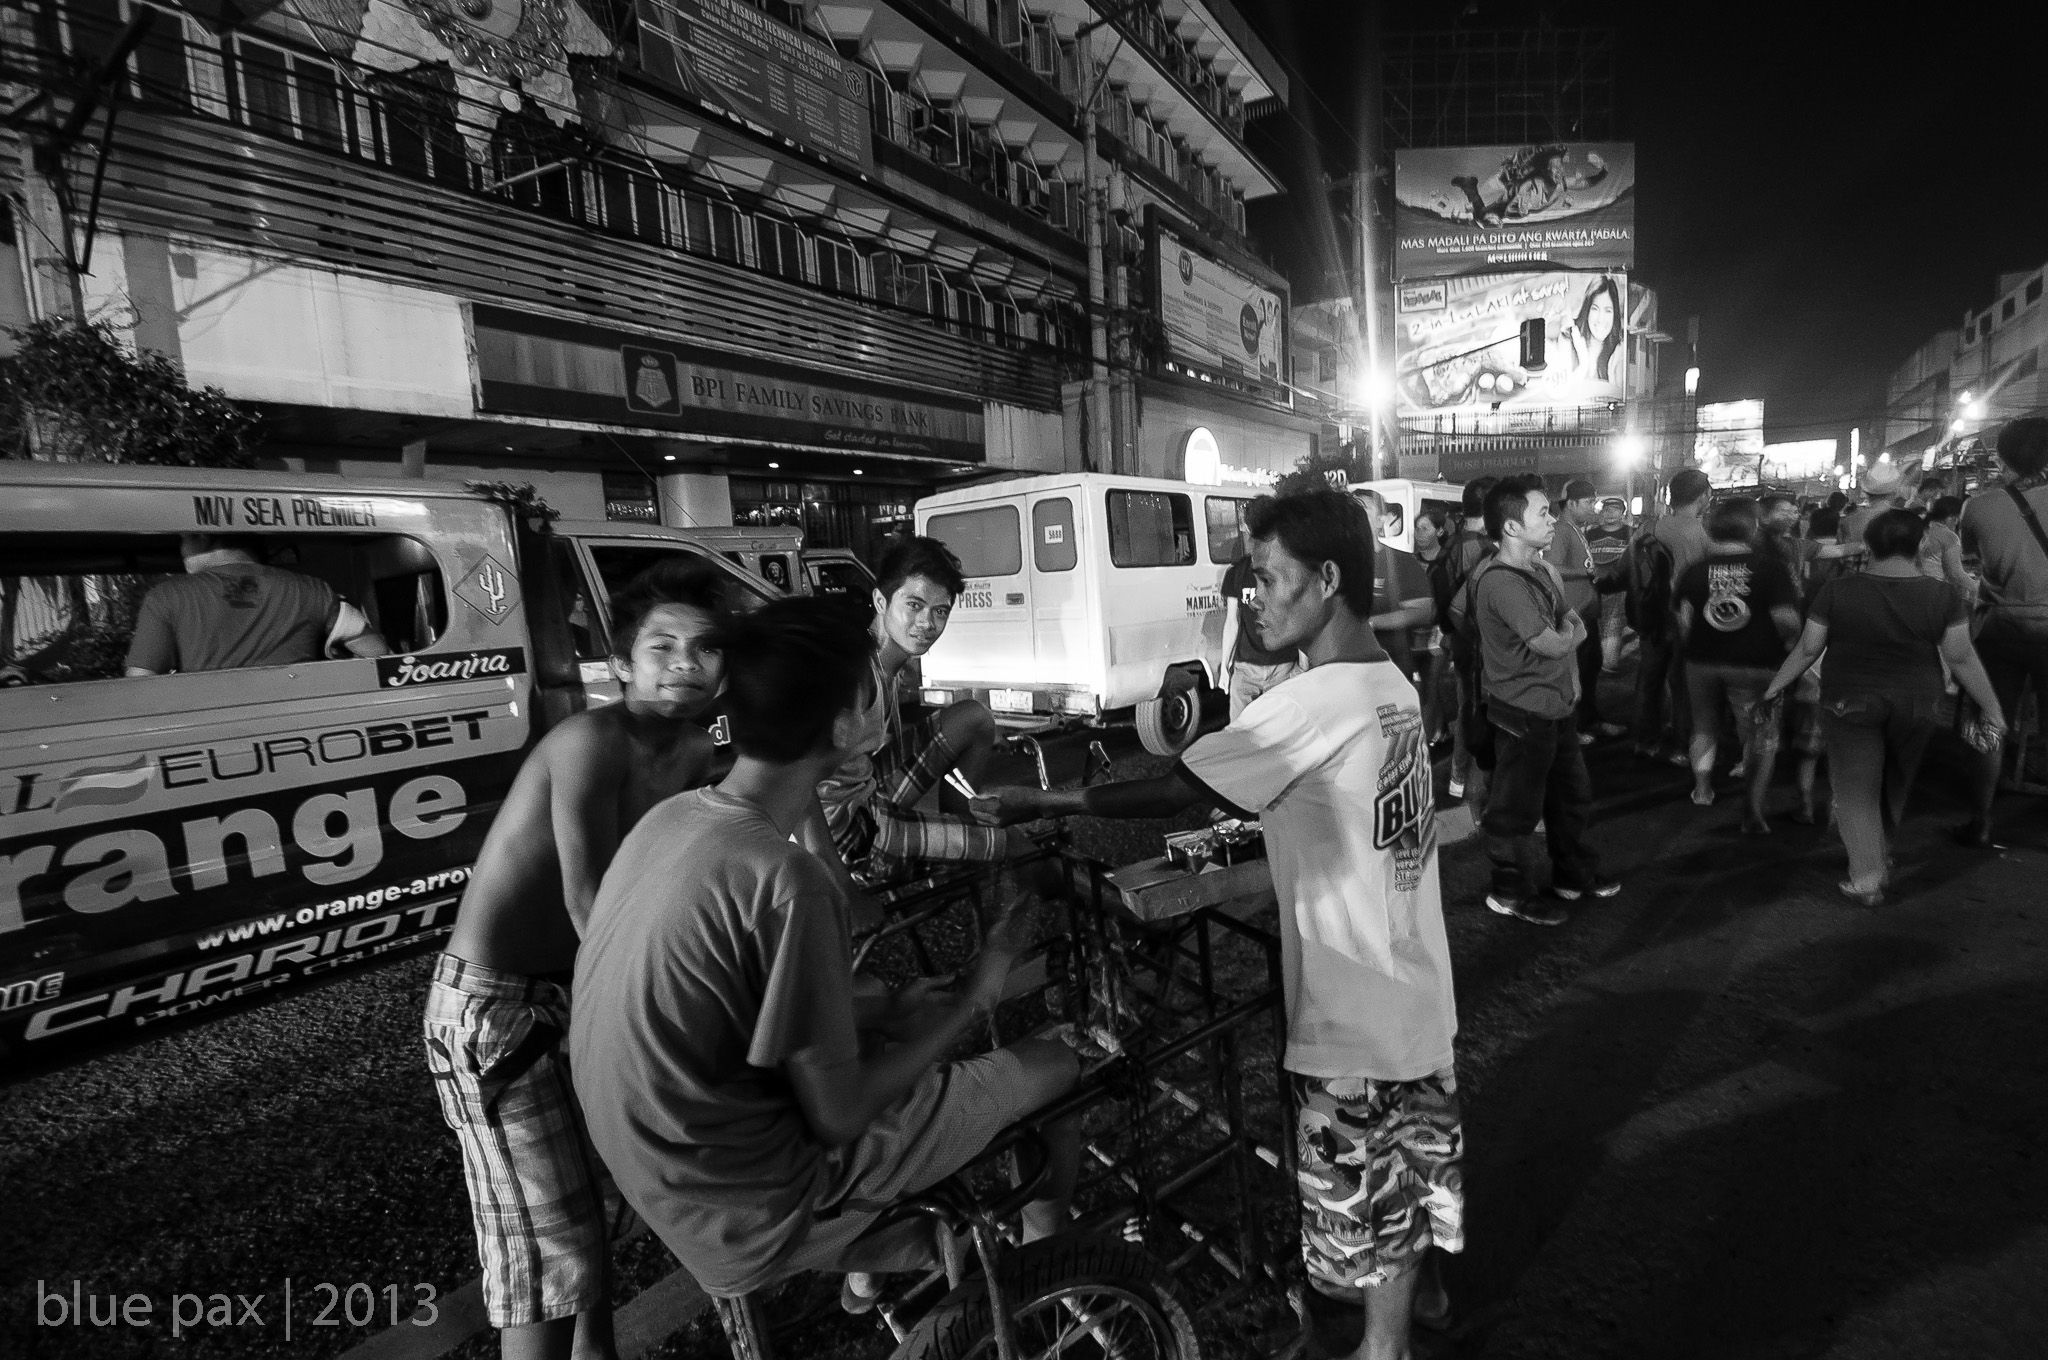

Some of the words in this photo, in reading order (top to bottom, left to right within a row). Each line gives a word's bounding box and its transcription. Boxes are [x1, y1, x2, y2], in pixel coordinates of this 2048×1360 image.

[730, 13, 749, 31] AND
[751, 25, 806, 63] ASSESSMENT
[809, 57, 838, 81] CENTER
[731, 0, 763, 28] VISAYAS
[763, 18, 802, 50] TECHNICAL
[802, 40, 842, 73] VOCATIONAL
[1400, 238, 1425, 250] MAS
[1427, 234, 1470, 248] MADALI
[1473, 233, 1486, 245] PA
[1489, 232, 1516, 244] DITO
[1518, 231, 1543, 243] ANG
[1545, 229, 1588, 242] KWARTA
[1512, 284, 1531, 306] at
[1531, 275, 1570, 302] sarap!
[690, 375, 726, 400] BPI
[734, 382, 804, 411] FAMILY
[811, 394, 884, 423] SAVINGS
[890, 406, 928, 429] BANK
[823, 429, 842, 441] Get
[192, 496, 234, 526] M/V
[243, 497, 286, 526] SEA
[292, 497, 377, 528] PREMIER
[958, 591, 993, 609] PRESS
[1186, 594, 1217, 611] MANILA
[157, 710, 490, 790] EUROBET
[24, 898, 458, 1041] CHARIOT
